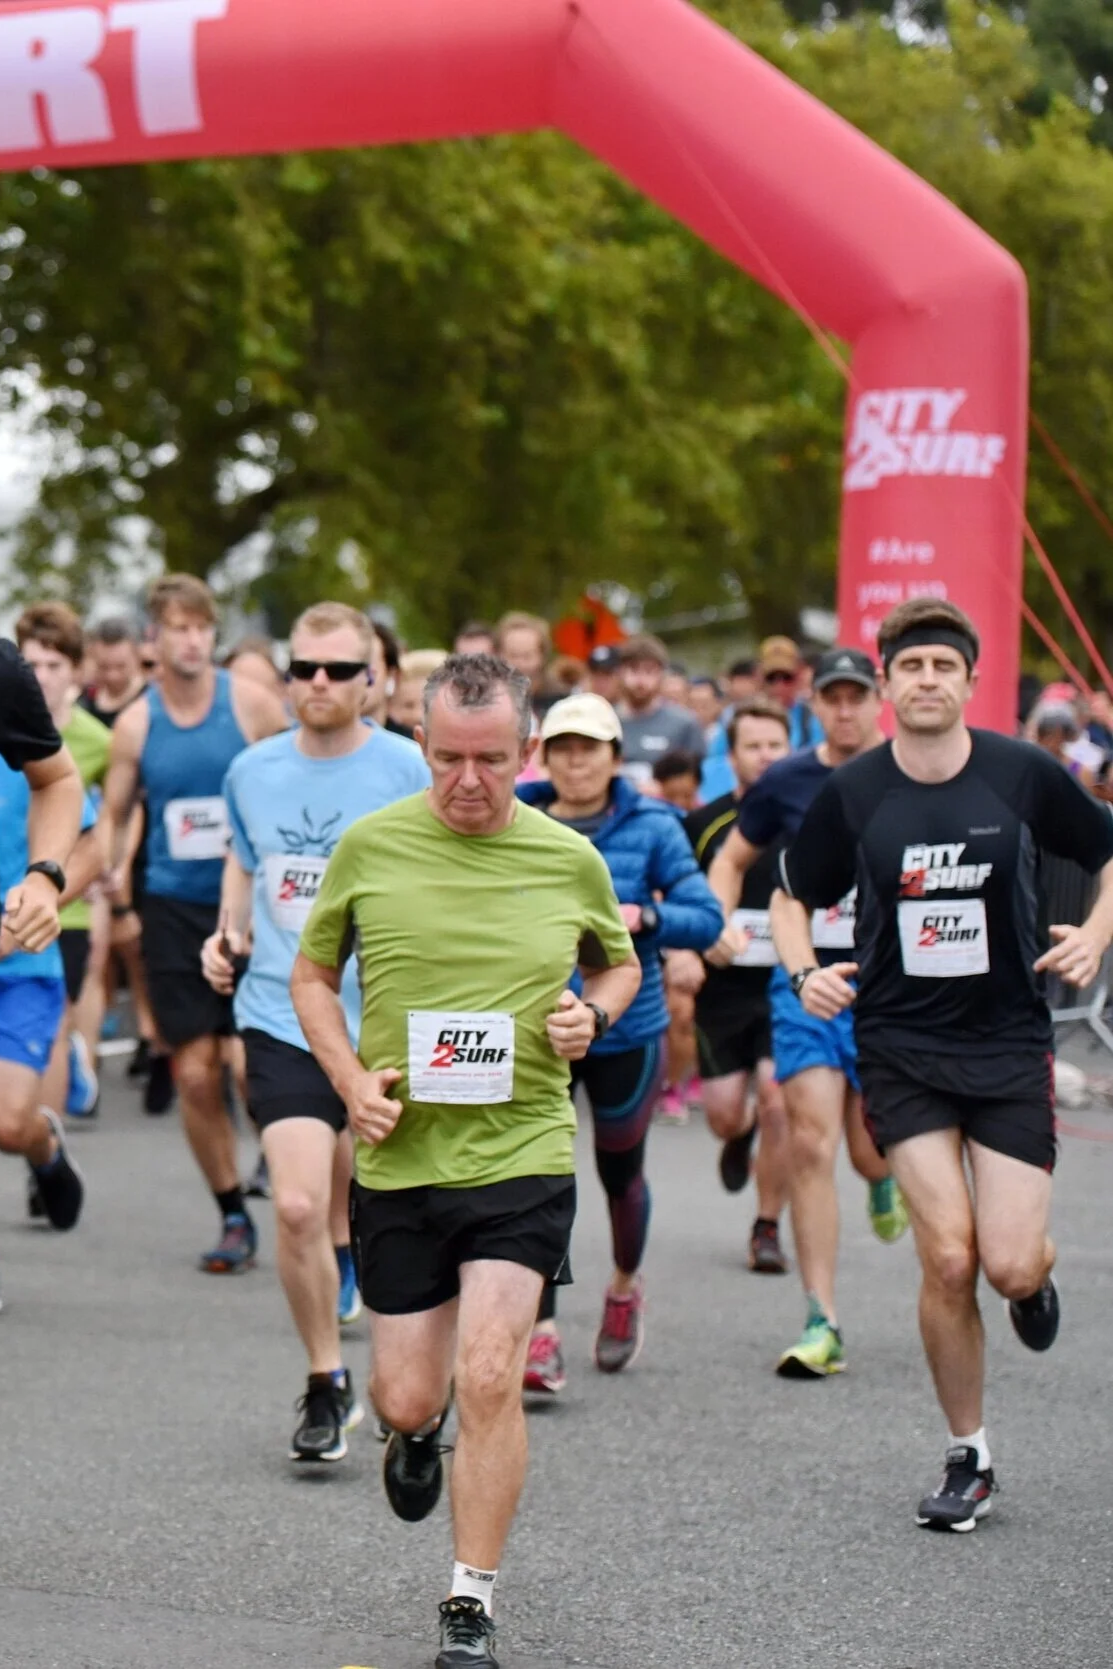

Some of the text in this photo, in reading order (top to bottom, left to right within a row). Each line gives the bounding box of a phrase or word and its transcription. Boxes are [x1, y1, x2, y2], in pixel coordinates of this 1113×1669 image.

[858, 388, 967, 431] CITY
[902, 842, 967, 871] CITY
[283, 869, 322, 885] CITY
[899, 862, 993, 896] 2SURF
[279, 881, 318, 899] 2SU
[922, 915, 963, 929] CITY
[918, 927, 980, 946] 2SURF
[437, 1030, 488, 1046] CITY
[429, 1044, 508, 1067] 2SURF
